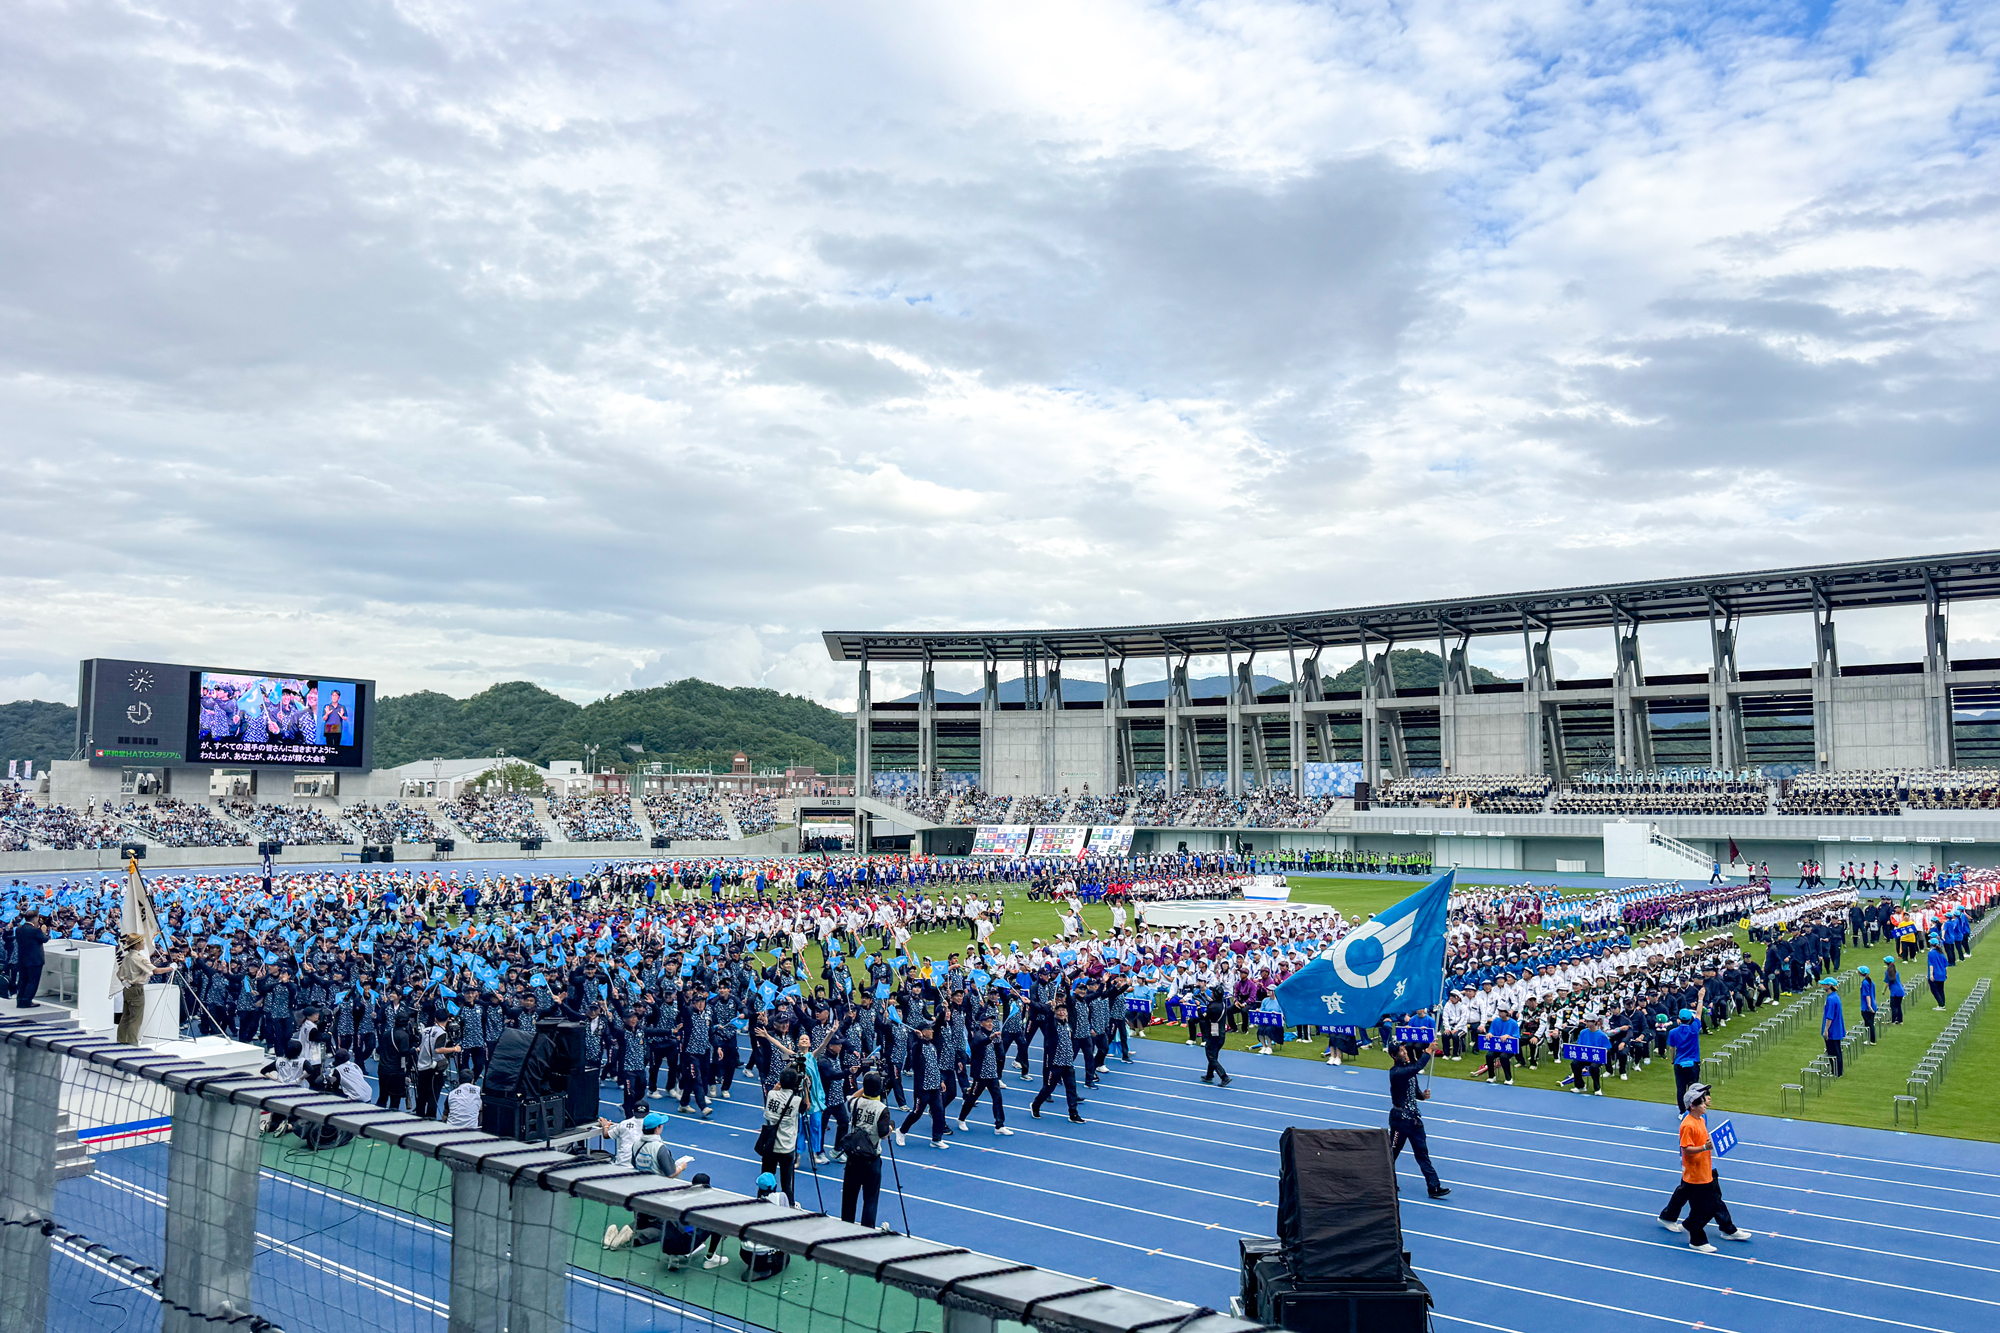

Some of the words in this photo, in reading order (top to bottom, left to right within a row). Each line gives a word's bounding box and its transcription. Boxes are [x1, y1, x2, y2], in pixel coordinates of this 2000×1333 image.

[1321, 1025, 1352, 1034] 和歌山県
[1401, 1032, 1429, 1042] 島根県
[1483, 1041, 1513, 1052] 広島県
[1569, 1050, 1600, 1062] 徳島県
